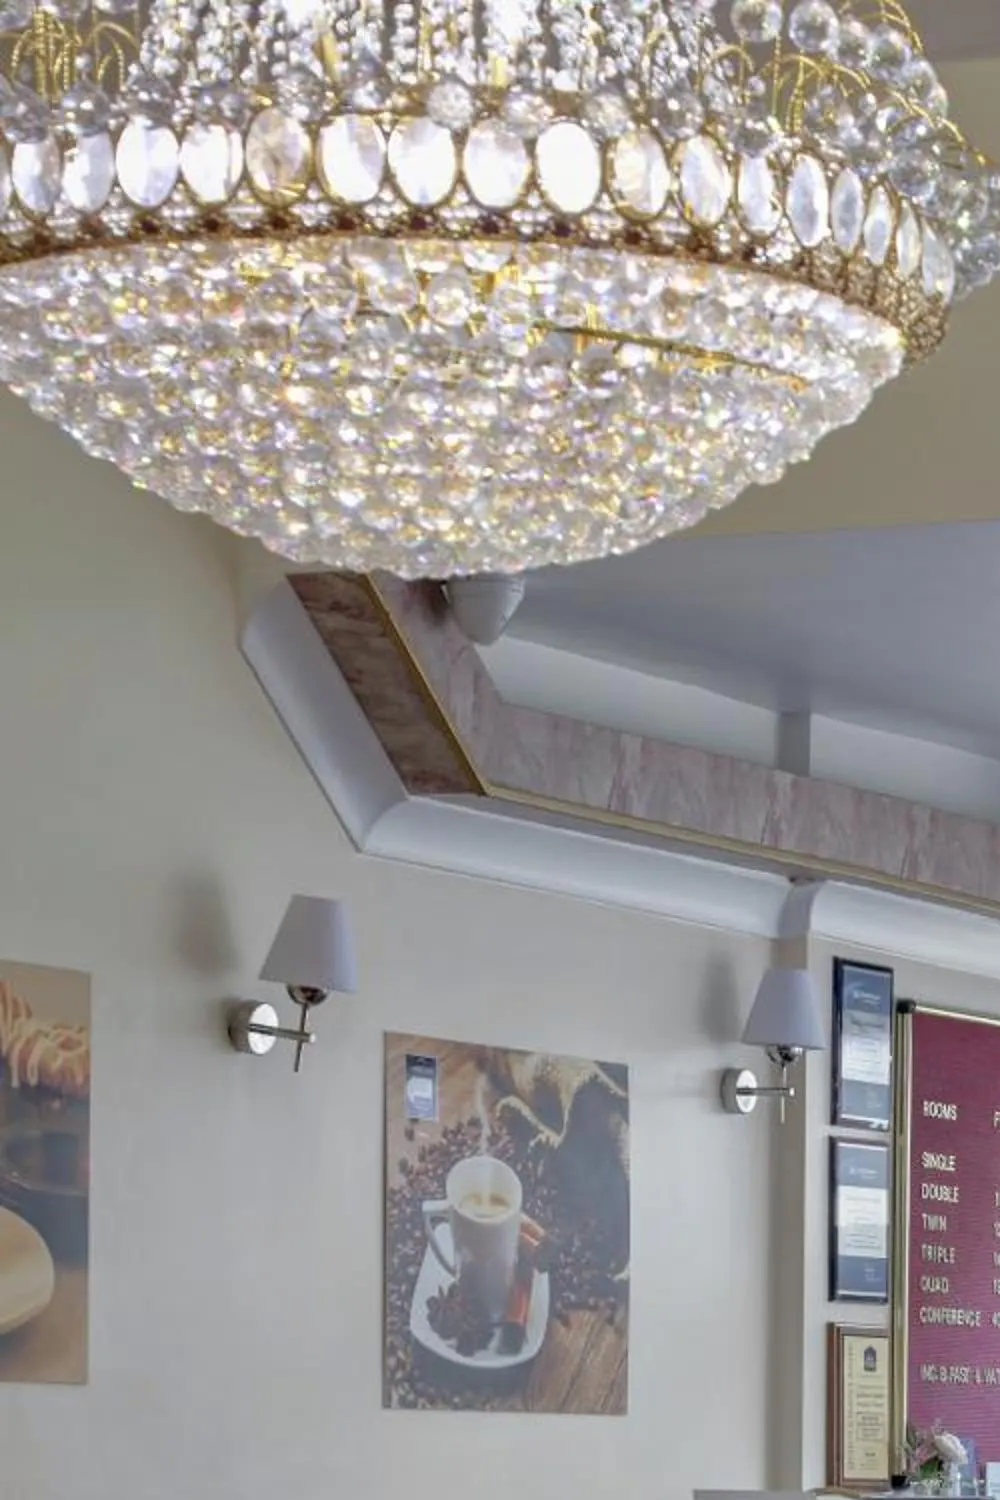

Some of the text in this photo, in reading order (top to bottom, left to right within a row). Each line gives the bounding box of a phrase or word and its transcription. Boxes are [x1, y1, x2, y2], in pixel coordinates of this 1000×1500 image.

[923, 1100, 957, 1120] ROOMS
[922, 1152, 956, 1171] SINGLE
[922, 1183, 959, 1203] DOUBLE
[922, 1213, 947, 1232] TWIN
[921, 1243, 956, 1264] TRIPLE
[920, 1276, 949, 1293] QUAD
[919, 1307, 981, 1327] CONFERENCE
